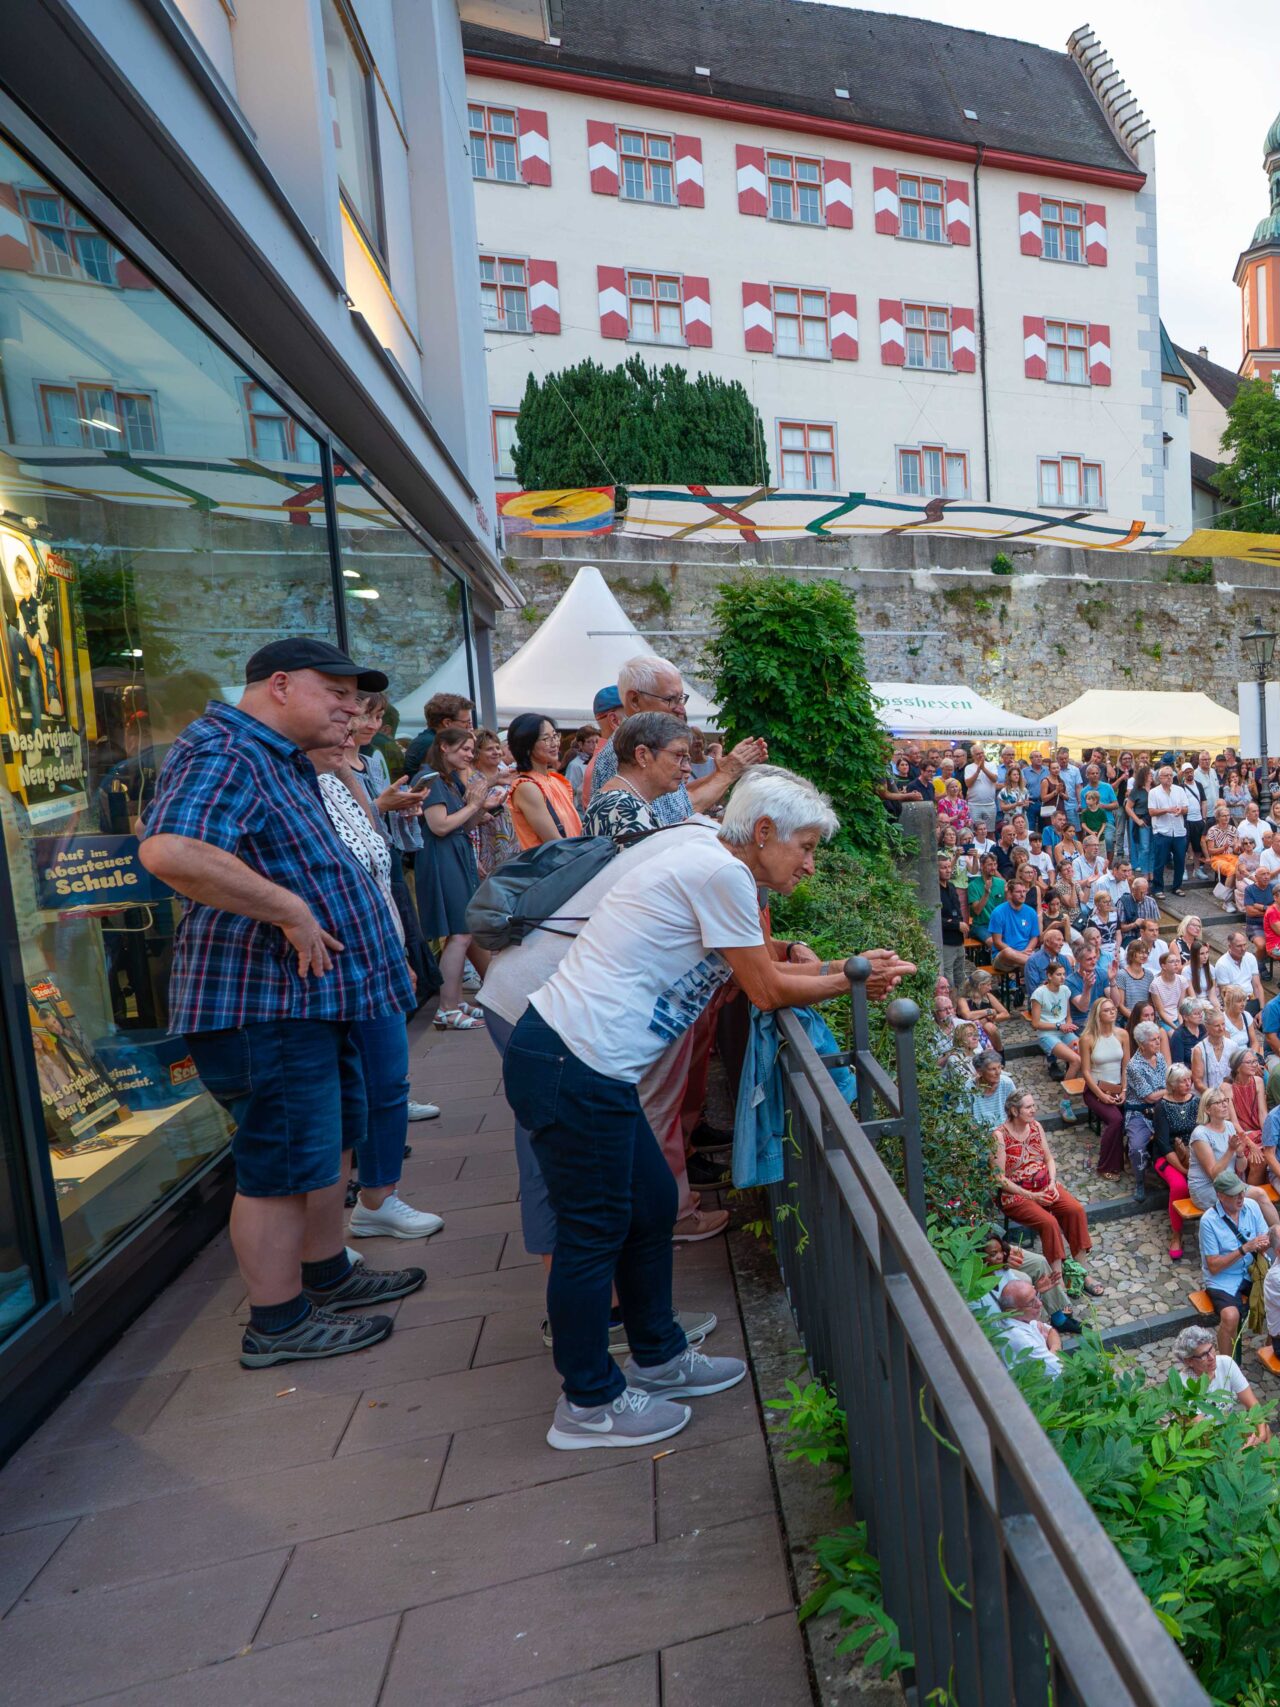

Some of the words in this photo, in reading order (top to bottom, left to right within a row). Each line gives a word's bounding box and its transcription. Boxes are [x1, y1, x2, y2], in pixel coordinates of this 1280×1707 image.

[9, 729, 34, 751] Das
[19, 764, 46, 787] Neu
[57, 848, 84, 861] Auf
[90, 849, 108, 858] ins
[45, 855, 133, 880] Abenteuer
[55, 869, 138, 895] Schule
[44, 1089, 63, 1106] Das
[56, 1103, 77, 1121] Neu
